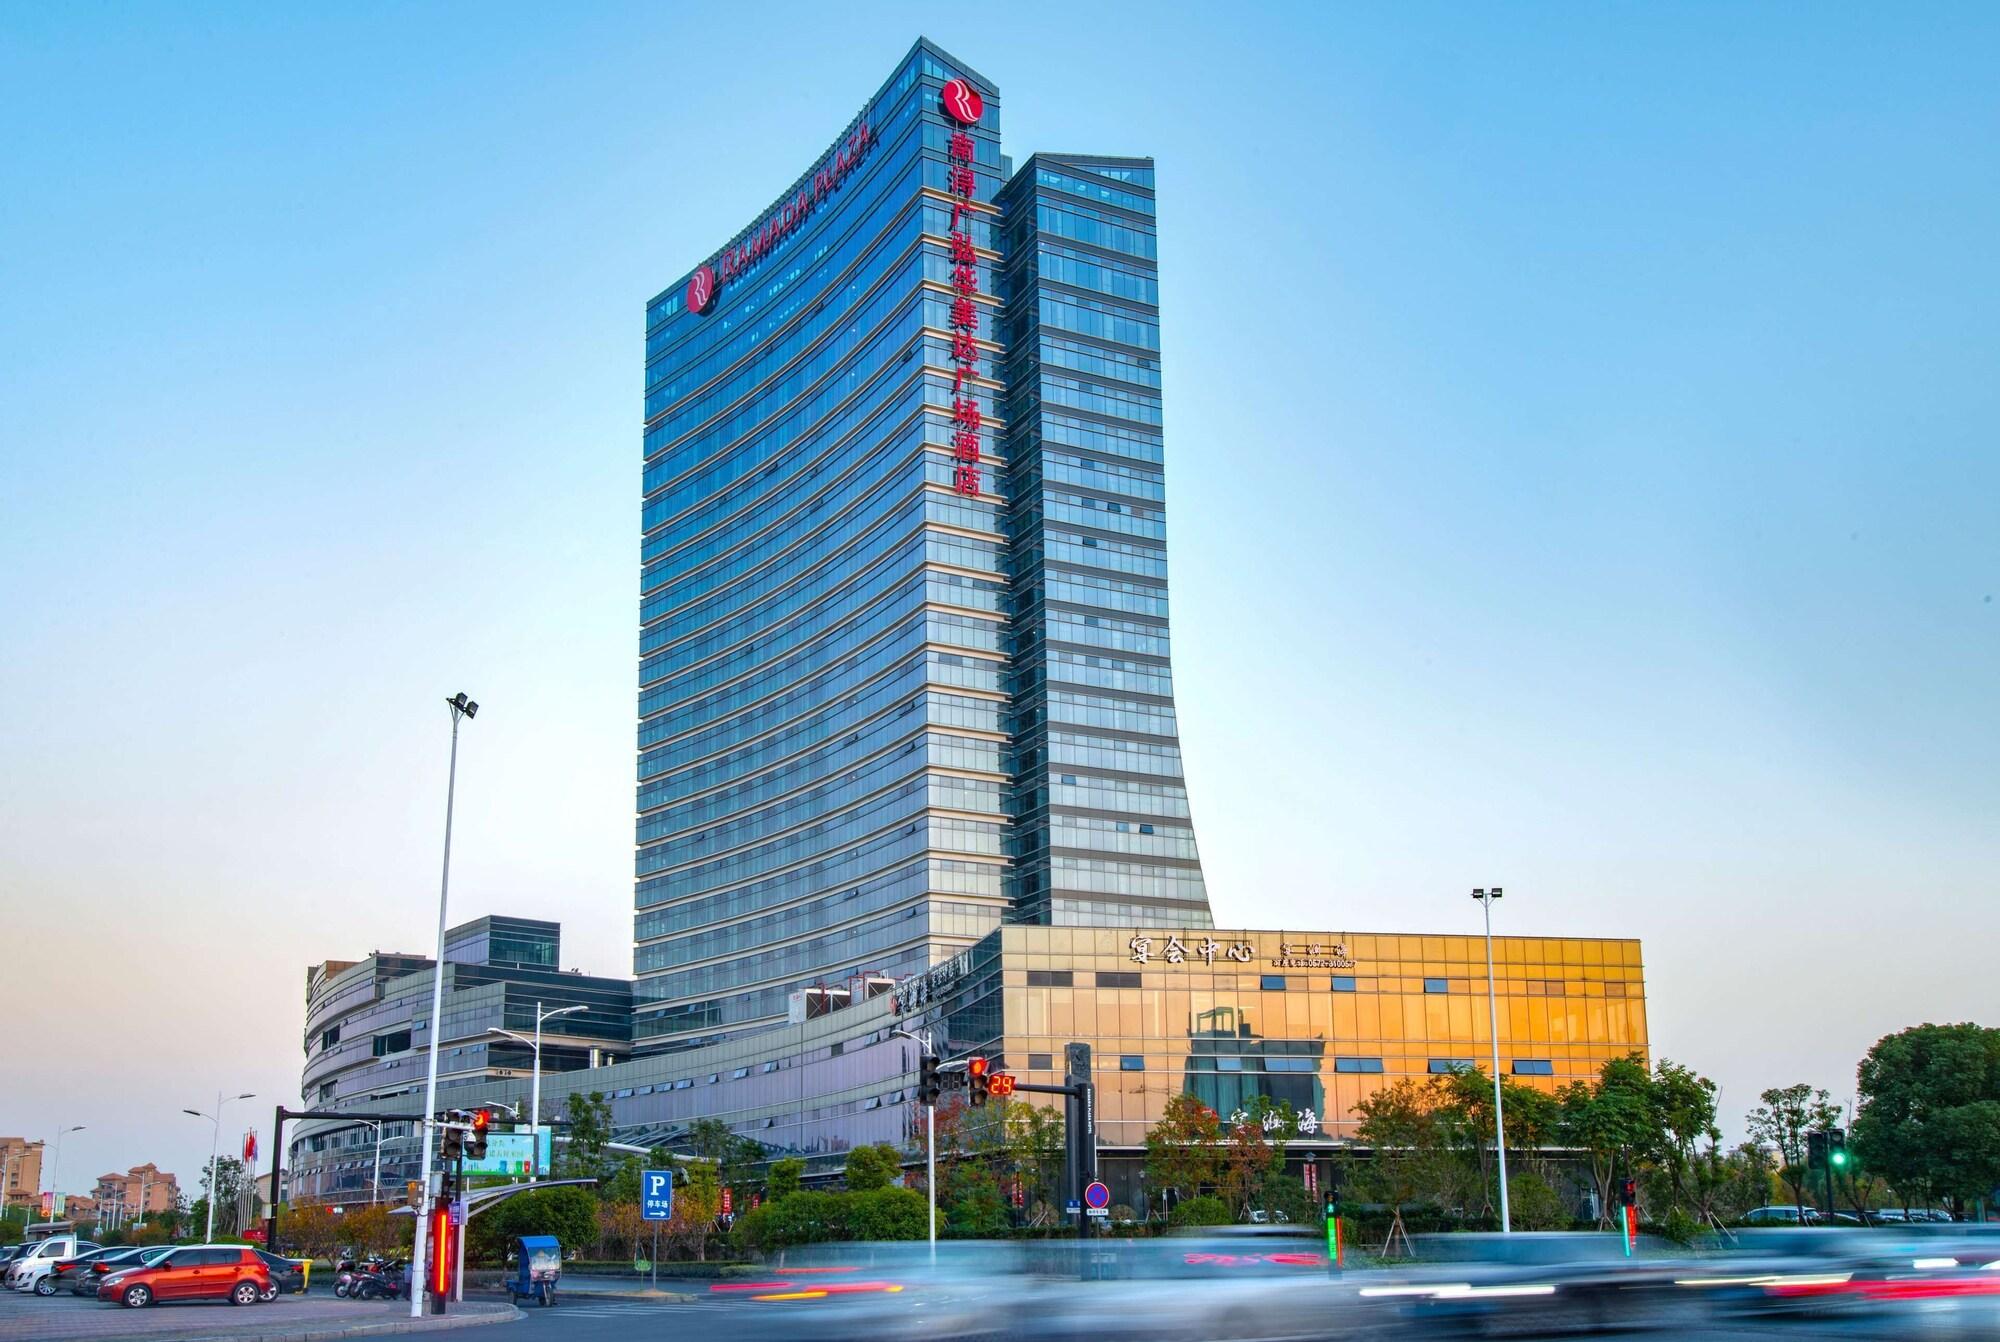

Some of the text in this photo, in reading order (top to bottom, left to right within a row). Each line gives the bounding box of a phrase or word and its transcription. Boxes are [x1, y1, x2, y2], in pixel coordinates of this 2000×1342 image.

[721, 122, 871, 283] RAMADA PLAZA
[1129, 935, 1256, 966] 宴会中心
[991, 1075, 1012, 1094] 29
[650, 1175, 666, 1196] P
[647, 1199, 668, 1209] 停车场
